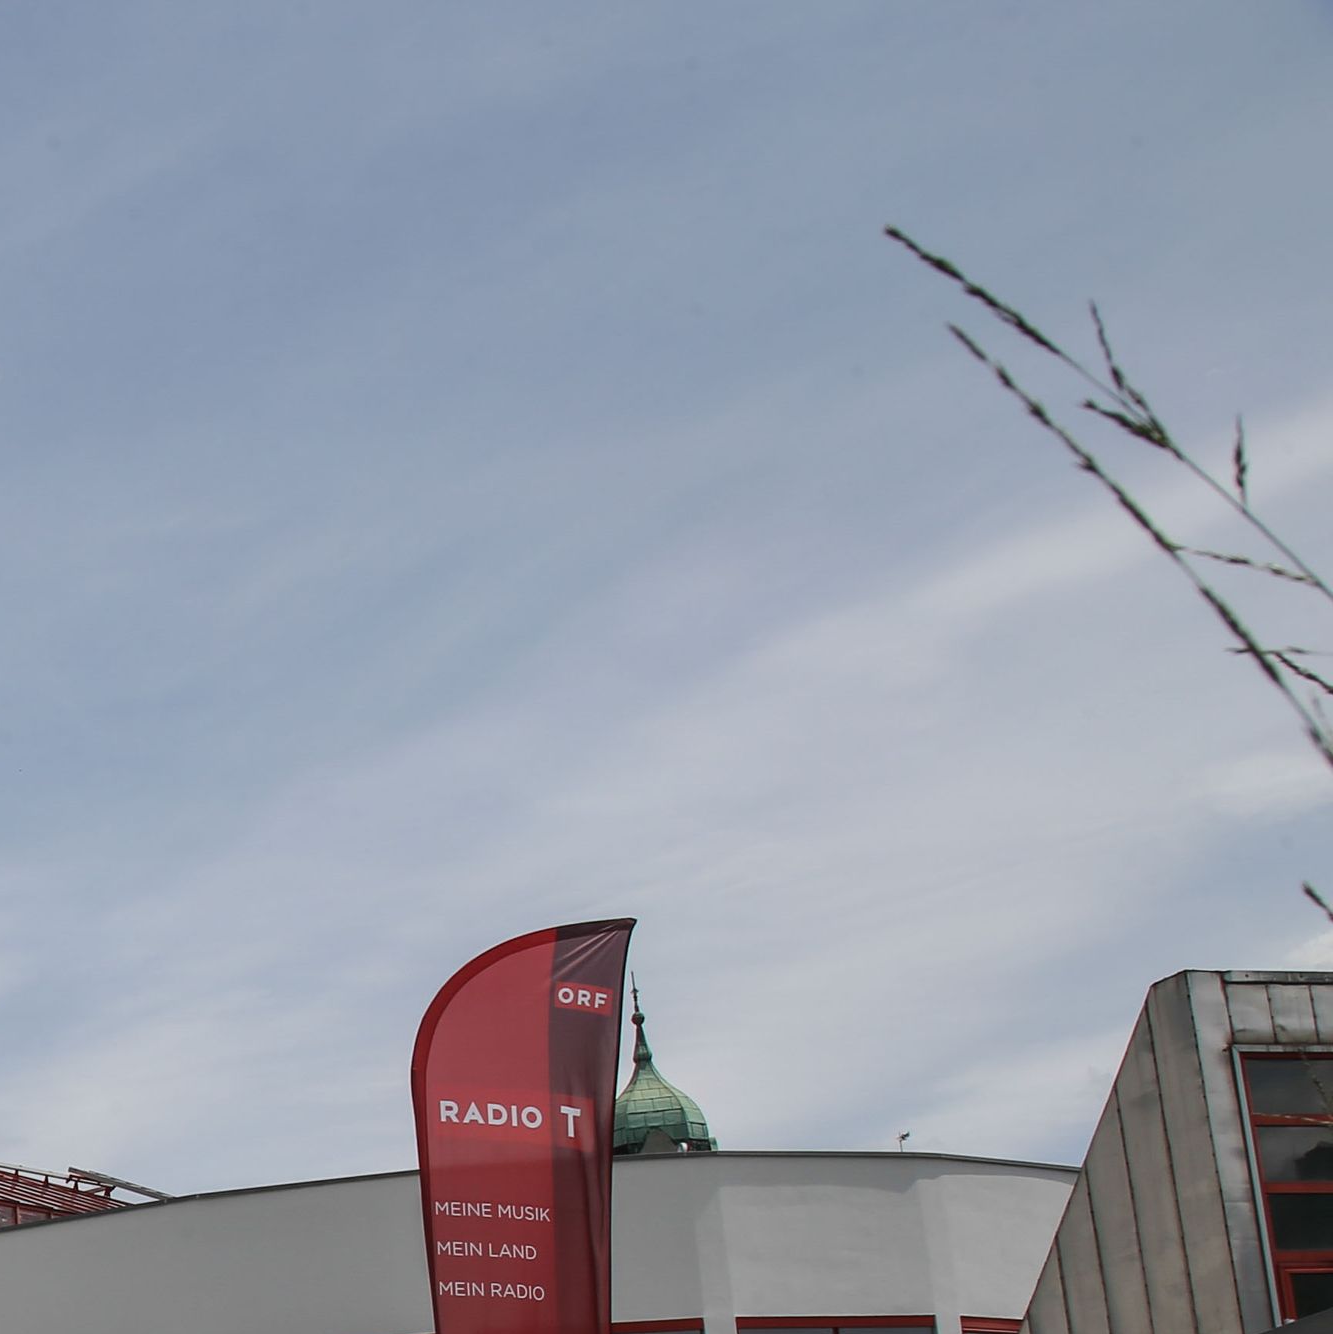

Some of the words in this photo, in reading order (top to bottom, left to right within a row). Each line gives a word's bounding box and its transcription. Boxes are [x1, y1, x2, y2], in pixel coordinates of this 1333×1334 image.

[558, 987, 608, 1009] ORF
[439, 1099, 543, 1129] RADIO
[560, 1105, 582, 1138] T
[434, 1201, 492, 1218] MEINE
[497, 1203, 551, 1222] MUSIK
[436, 1241, 483, 1257] MEIN
[488, 1243, 537, 1260] LAND
[439, 1281, 485, 1297] MEIN
[490, 1282, 545, 1301] RADIO
